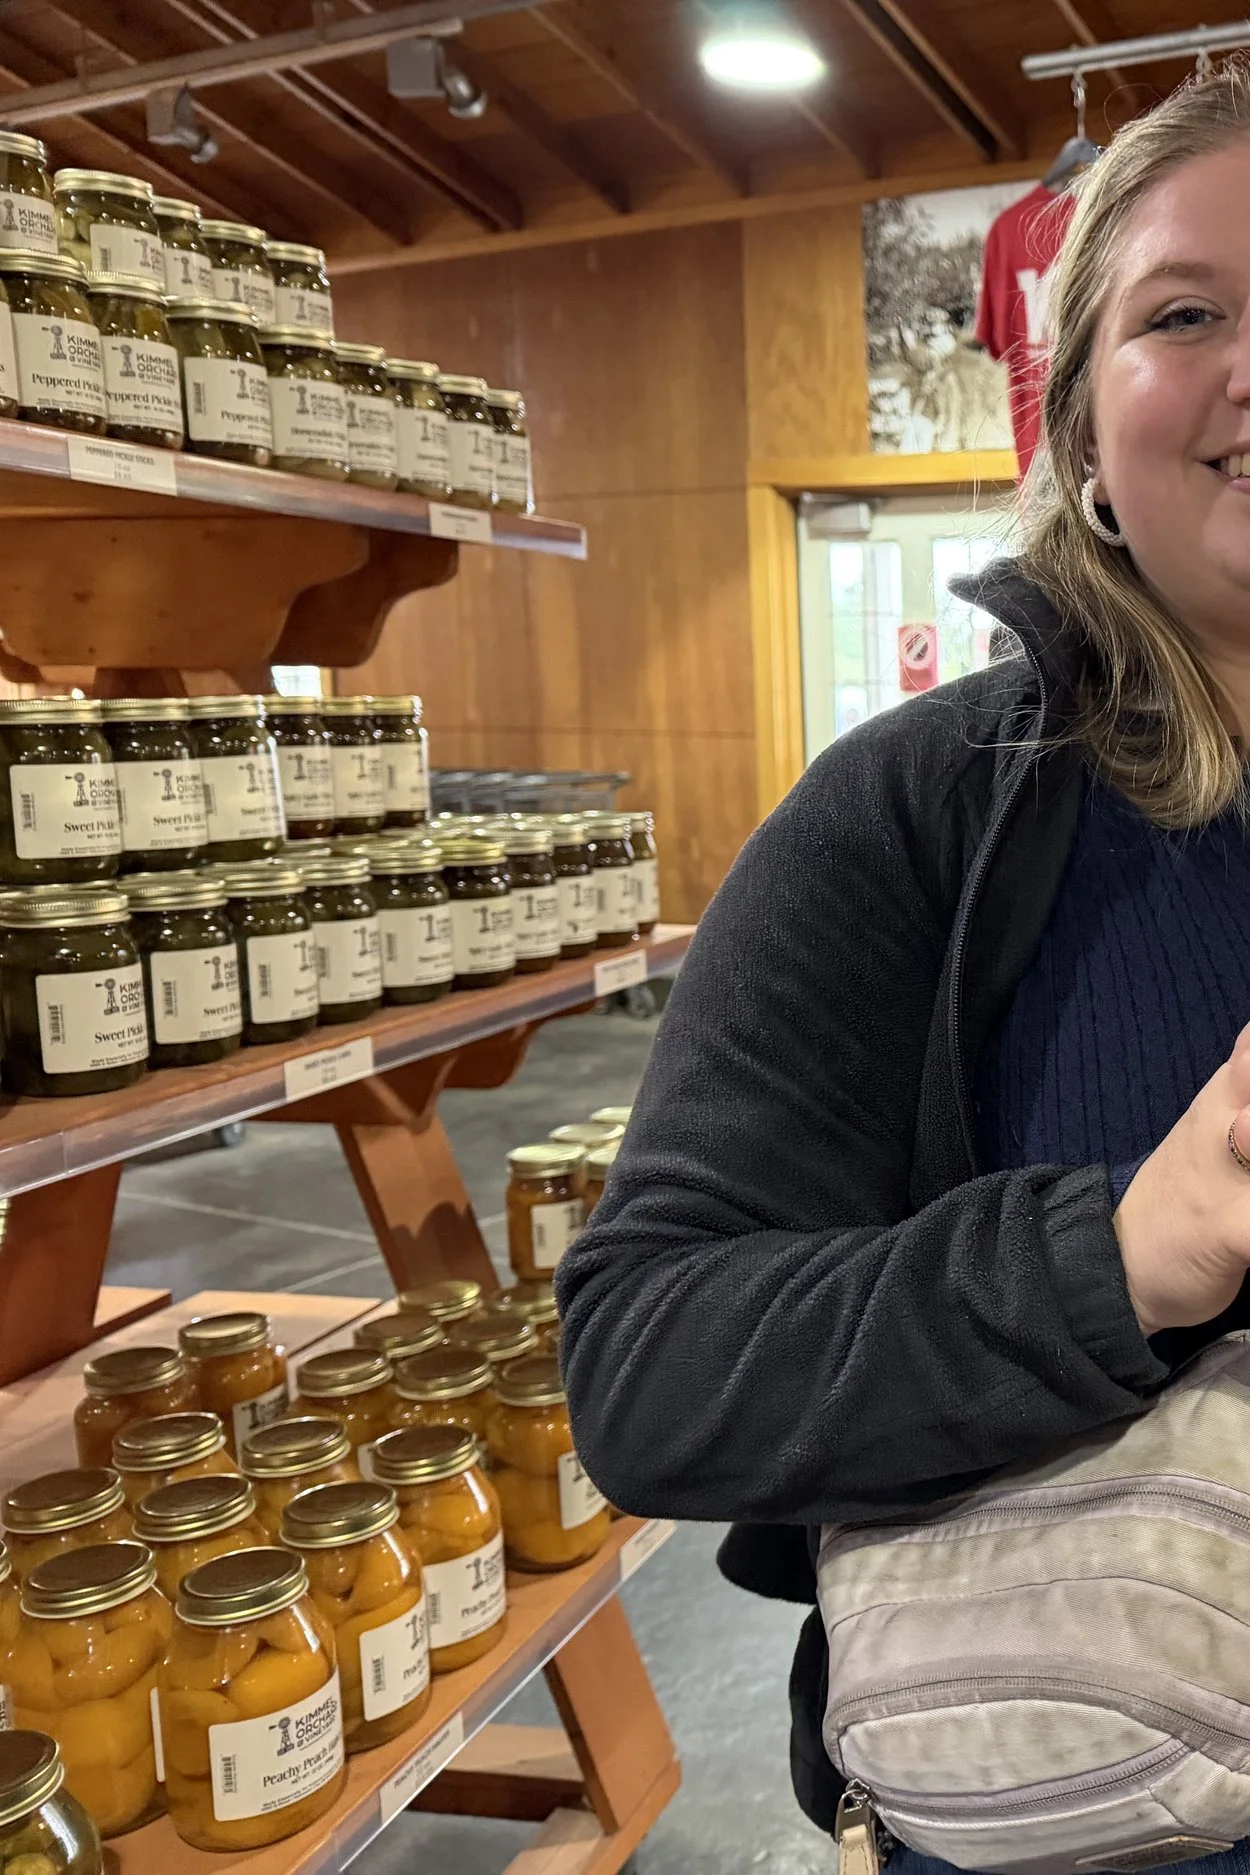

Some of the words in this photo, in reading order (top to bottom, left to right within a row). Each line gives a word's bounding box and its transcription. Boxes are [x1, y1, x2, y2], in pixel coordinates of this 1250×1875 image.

[68, 345, 101, 361] ORCHA
[32, 373, 80, 388] Peppered
[64, 820, 95, 833] Sweet
[119, 980, 143, 994] KIMM
[94, 1028, 125, 1044] Sweet
[263, 1764, 301, 1787] Peachy
[303, 1747, 328, 1770] Peach
